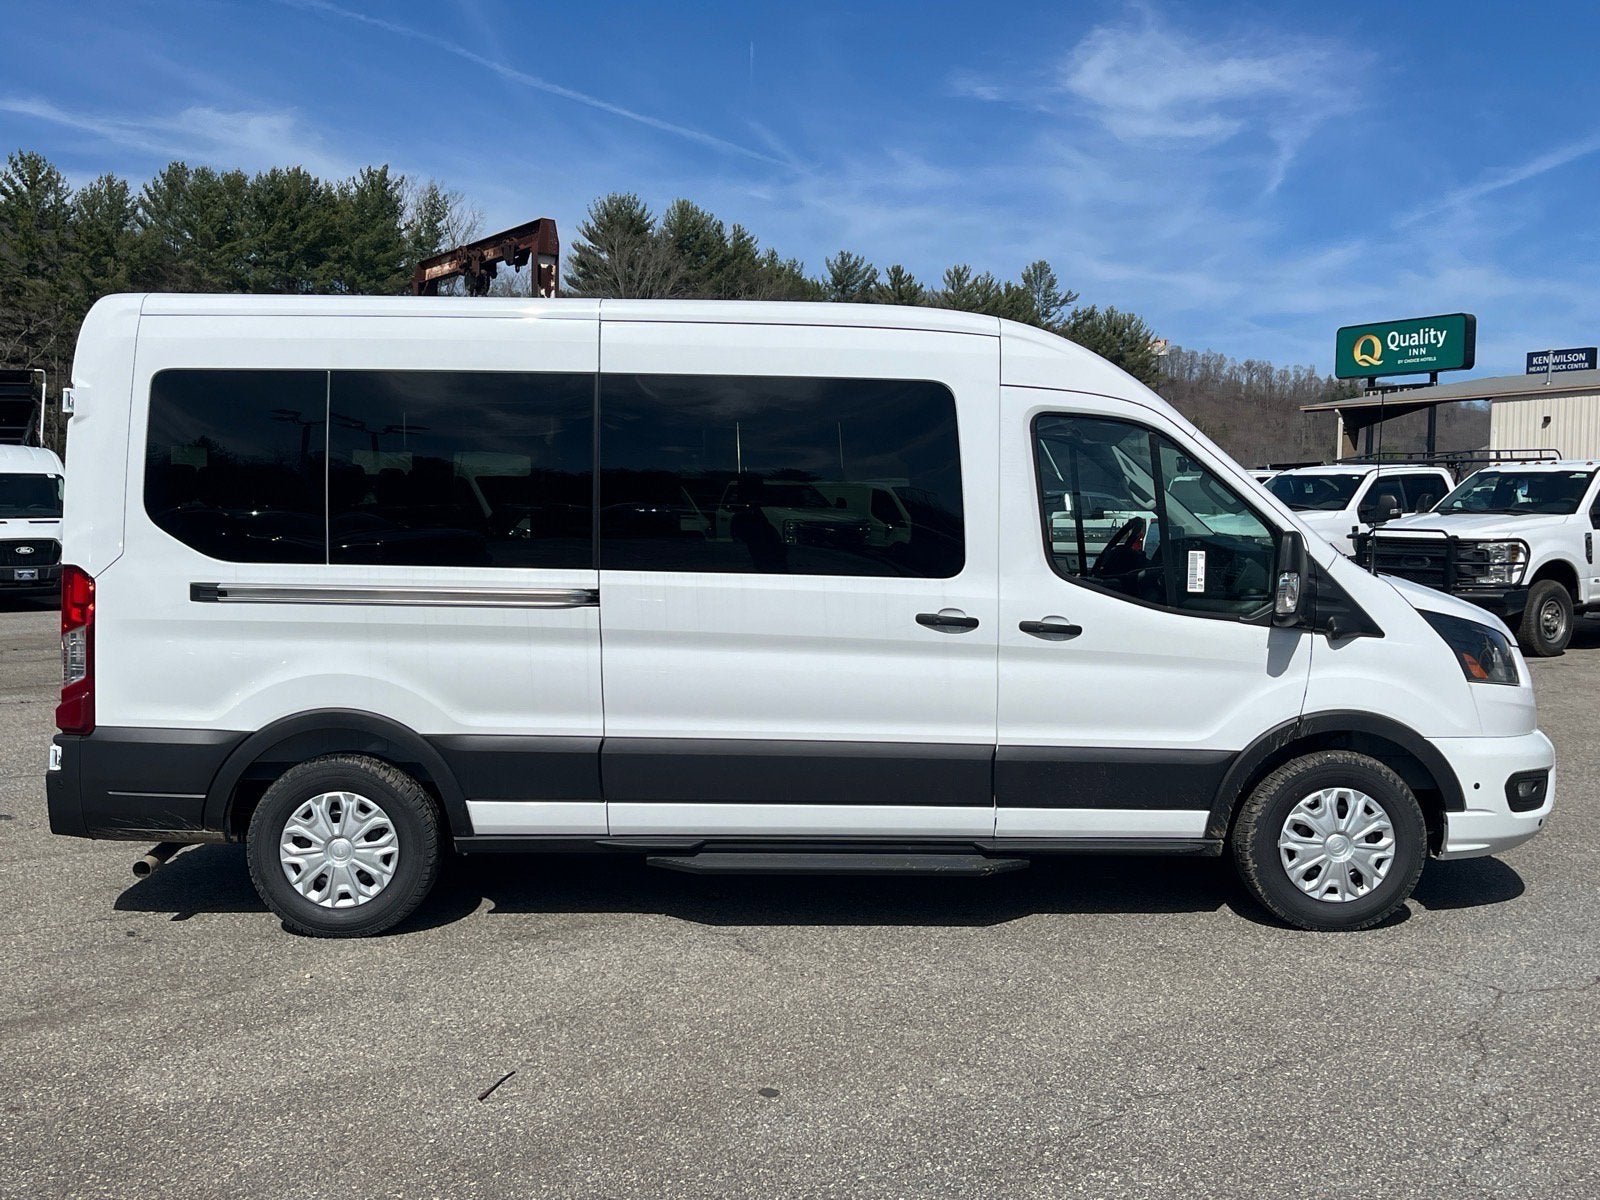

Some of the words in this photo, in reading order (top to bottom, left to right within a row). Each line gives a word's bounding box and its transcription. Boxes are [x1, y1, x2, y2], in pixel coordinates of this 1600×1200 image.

[1387, 327, 1447, 351] Quality
[1408, 347, 1427, 356] INN
[1532, 356, 1549, 365] KEN
[1552, 352, 1586, 363] WILSON
[1567, 362, 1589, 370] CENTER
